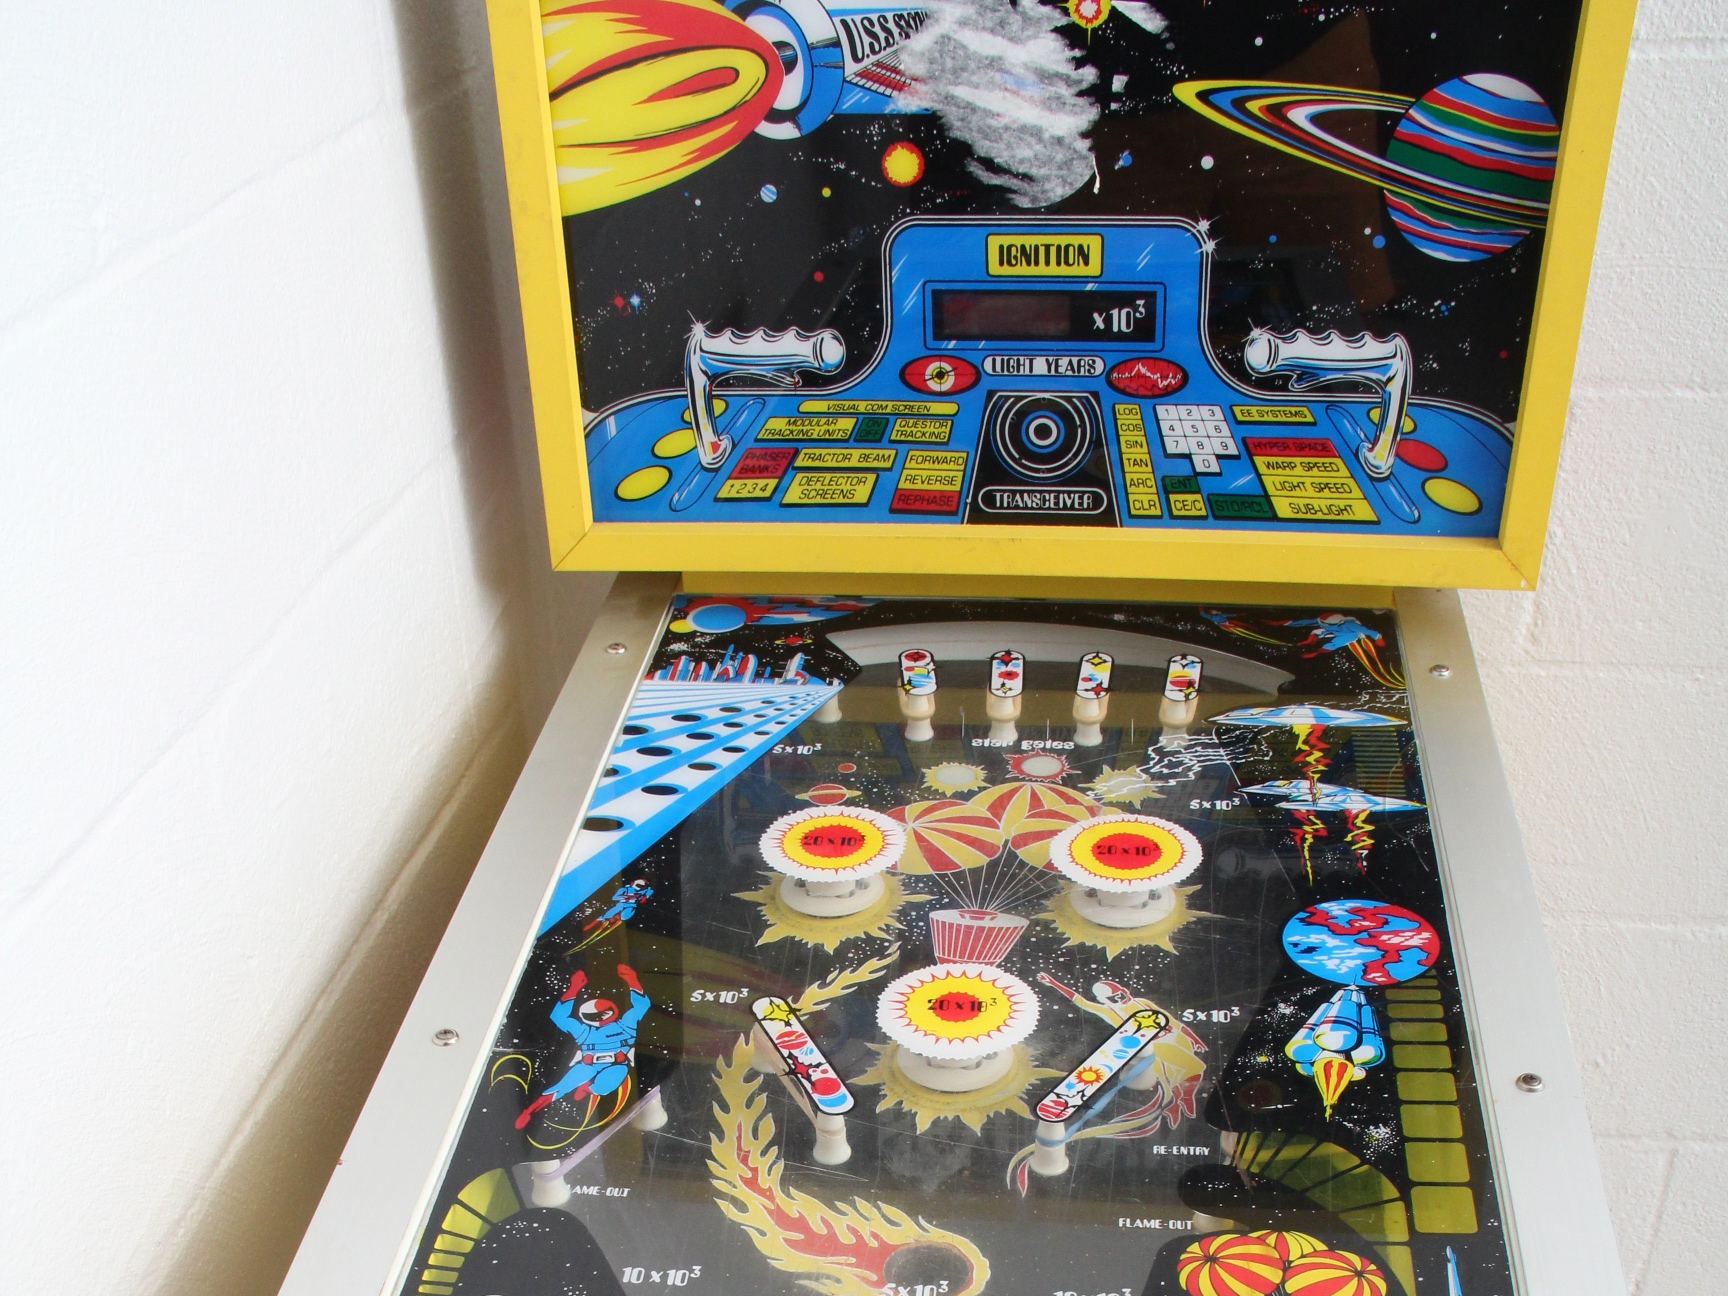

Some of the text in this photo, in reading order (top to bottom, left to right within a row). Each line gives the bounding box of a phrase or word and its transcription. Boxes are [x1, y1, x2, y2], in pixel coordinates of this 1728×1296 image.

[840, 14, 899, 64] U.S.S.
[998, 243, 1091, 268] IGNITION
[991, 357, 1096, 376] LIGHT YEARS
[827, 403, 931, 413] VISUAL COM SCREEN
[1117, 407, 1139, 417] LOG
[1165, 408, 1170, 416] 1
[1185, 408, 1193, 417] 2
[1208, 408, 1216, 417] 3
[1240, 410, 1307, 419] EE SYSTEMS
[785, 418, 837, 427] MODULAR
[899, 420, 949, 430] QUESTOR
[1120, 423, 1143, 433] COS
[762, 428, 849, 438] TRACKING UNITS
[1168, 424, 1175, 433] 4
[1191, 424, 1199, 433] 5
[1213, 424, 1222, 433] 6
[894, 430, 947, 441] TRACKING
[1125, 439, 1144, 449] SIN
[1172, 440, 1179, 449] 7
[1196, 440, 1205, 450] 8
[1220, 440, 1229, 450] 9
[1252, 442, 1331, 452] HYPER SPACE
[744, 451, 790, 461] PHASER
[801, 452, 891, 464] TRACTOR BEAM
[909, 454, 965, 466] FORWARD
[1127, 457, 1149, 468] TAN
[1263, 461, 1341, 472] WARP SPEED
[739, 464, 779, 474] BANKS
[799, 475, 868, 487] DEFLECTOR
[904, 474, 958, 486] REVERSE
[1128, 476, 1153, 488] ARC
[1170, 478, 1192, 489] ENT
[1272, 481, 1353, 494] LIGHT SPEED
[799, 488, 856, 500] SCREENS
[897, 494, 954, 507] REPHASE
[992, 492, 1093, 509] TRANSCEIVER
[1132, 499, 1157, 511] CLR
[1173, 499, 1203, 511] CE/C
[1289, 502, 1355, 516] SUB-LIGHT
[1021, 739, 1075, 750] gates
[927, 998, 950, 1011] 20
[1153, 1145, 1210, 1156] RE-ENTRY
[567, 1184, 631, 1197] AME-OUT
[1118, 1218, 1193, 1230] FLAME-OUT
